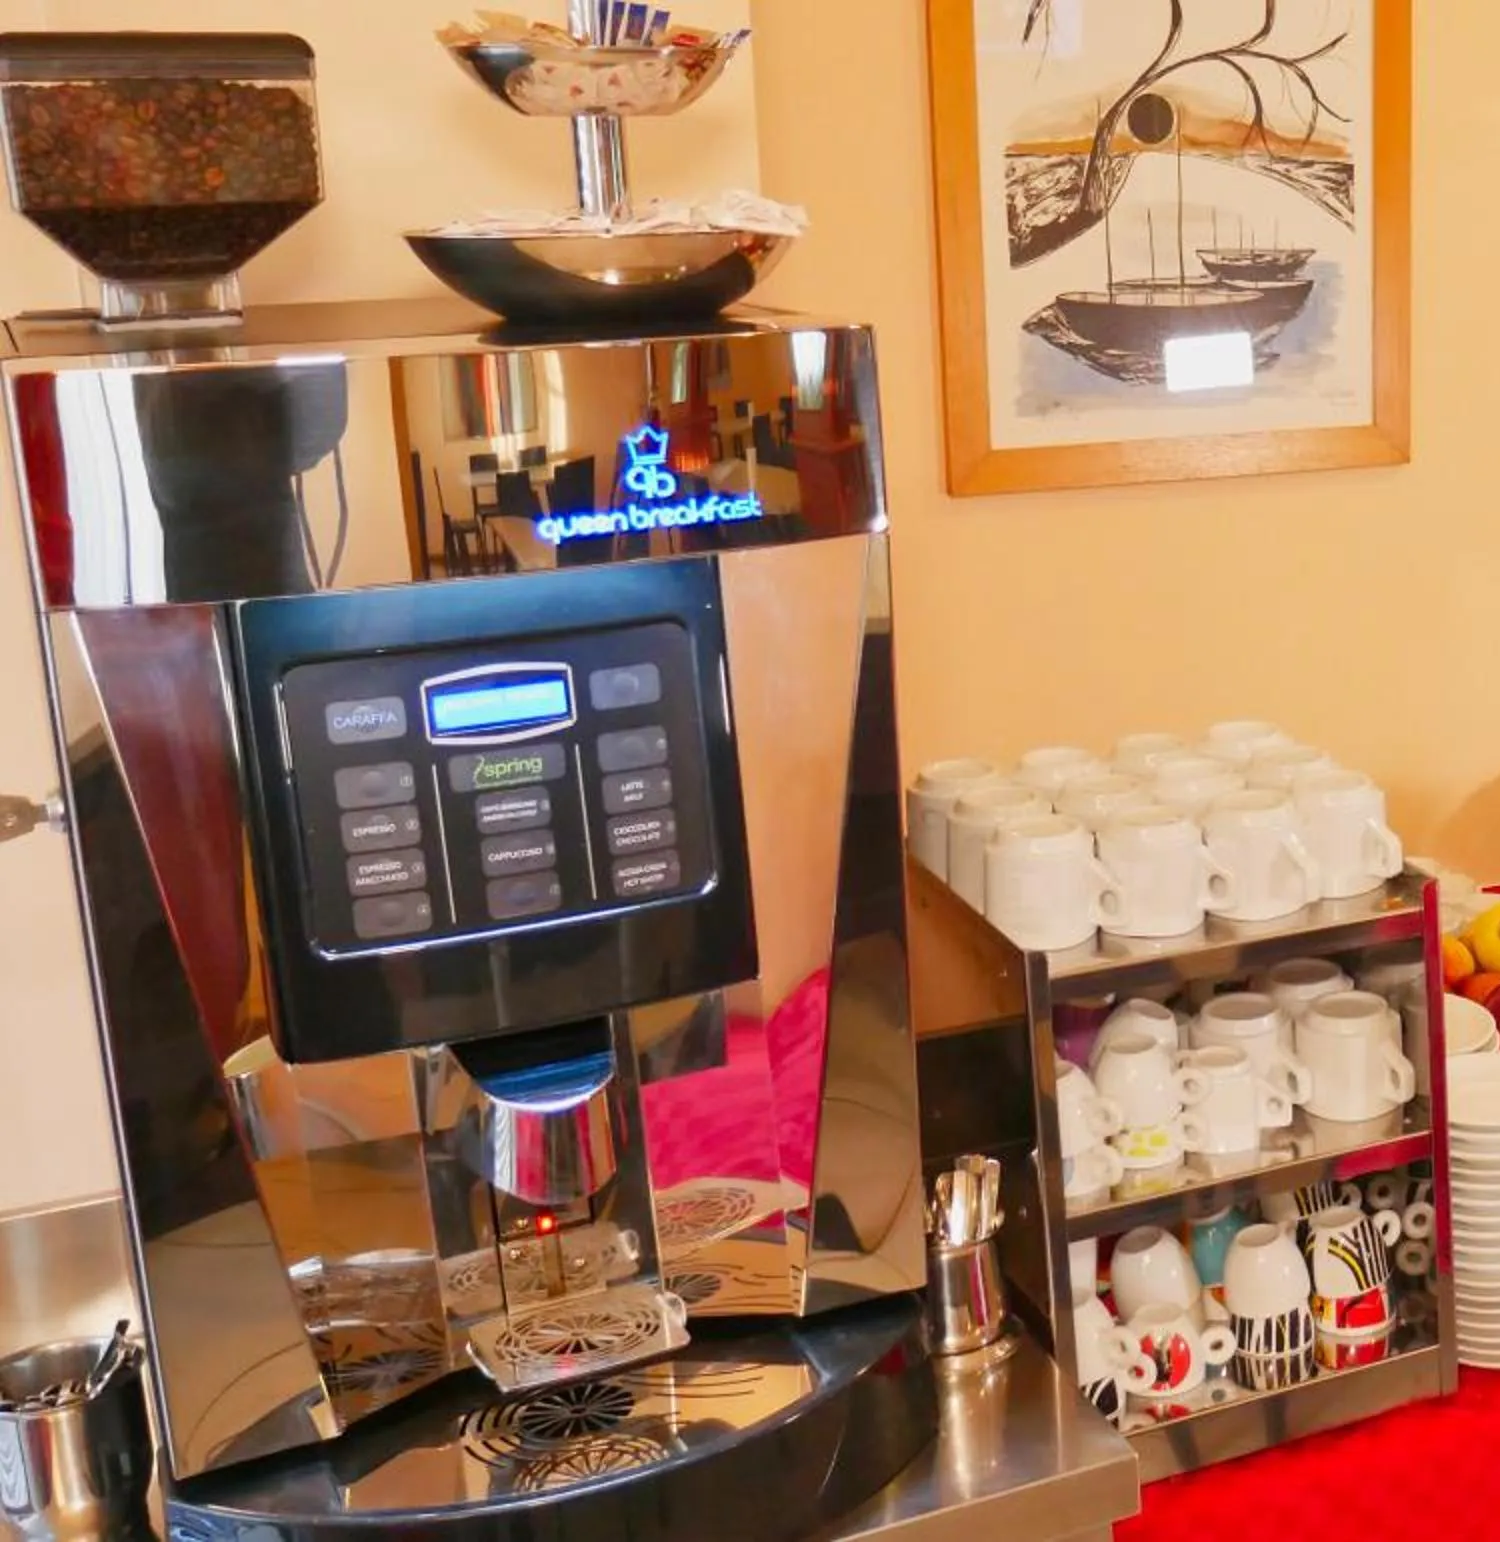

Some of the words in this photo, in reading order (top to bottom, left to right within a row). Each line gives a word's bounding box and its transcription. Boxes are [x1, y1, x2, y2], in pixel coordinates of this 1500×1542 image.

[537, 509, 629, 544] queen
[628, 491, 762, 530] breakfast
[484, 758, 543, 779] spring
